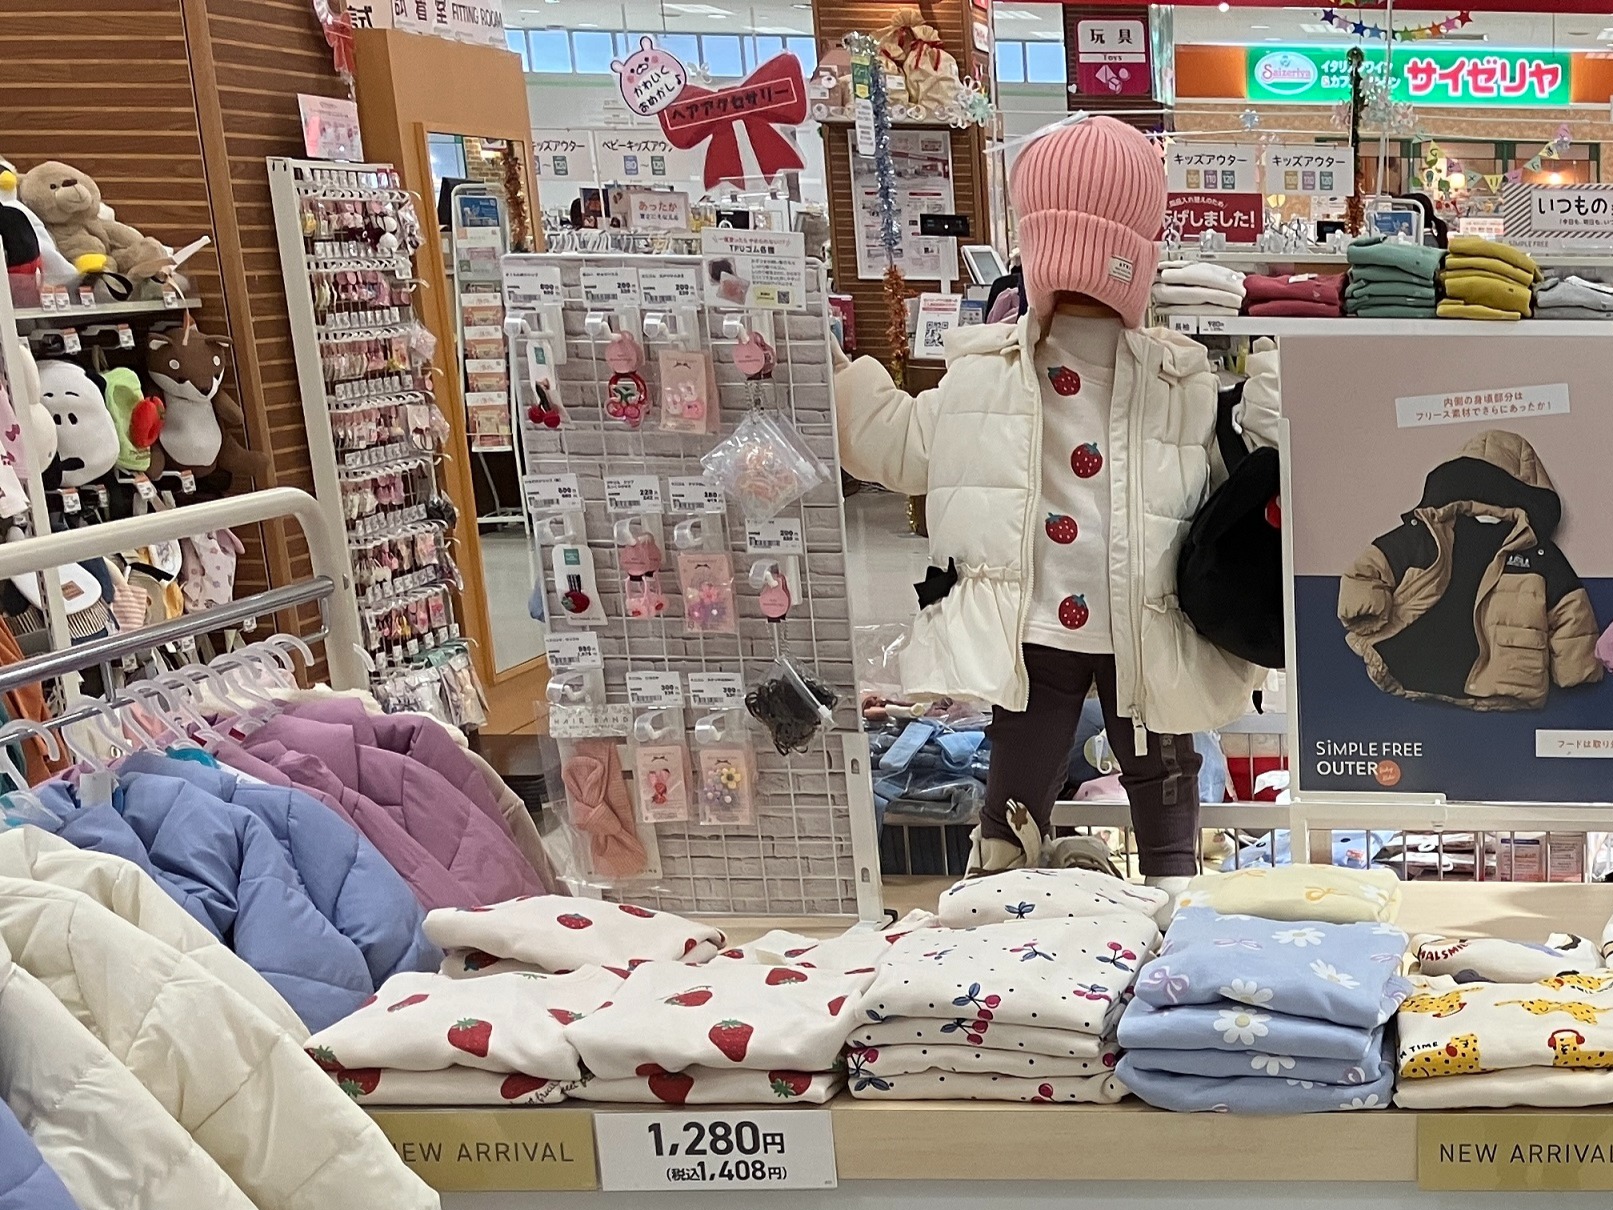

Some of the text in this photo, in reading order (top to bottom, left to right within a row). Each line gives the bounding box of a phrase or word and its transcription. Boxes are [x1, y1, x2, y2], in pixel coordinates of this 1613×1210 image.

[451, 4, 503, 29] FITTING ROOM
[1089, 27, 1134, 46] 玩具
[1102, 54, 1123, 62] Toys
[633, 64, 670, 98] かわいく
[1262, 63, 1312, 83] Saizeriya
[1404, 57, 1564, 97] サイゼリヤ
[672, 87, 790, 120] ヘアアクセサリー
[1173, 154, 1248, 167] キッズアウター
[1272, 155, 1346, 168] キッズアウター
[1205, 174, 1217, 184] 110
[1222, 174, 1234, 184] 120
[1320, 175, 1333, 185] 120
[639, 202, 677, 211] あったか
[1538, 197, 1608, 216] いつもの
[554, 716, 629, 725] HAIR BAND
[1382, 742, 1423, 757] FREE
[1316, 760, 1379, 776] OUTER
[1409, 1041, 1439, 1054] TIME
[647, 1121, 785, 1157] 1,280円
[457, 1142, 575, 1162] ARRIVAL
[1440, 1144, 1498, 1163] NEW
